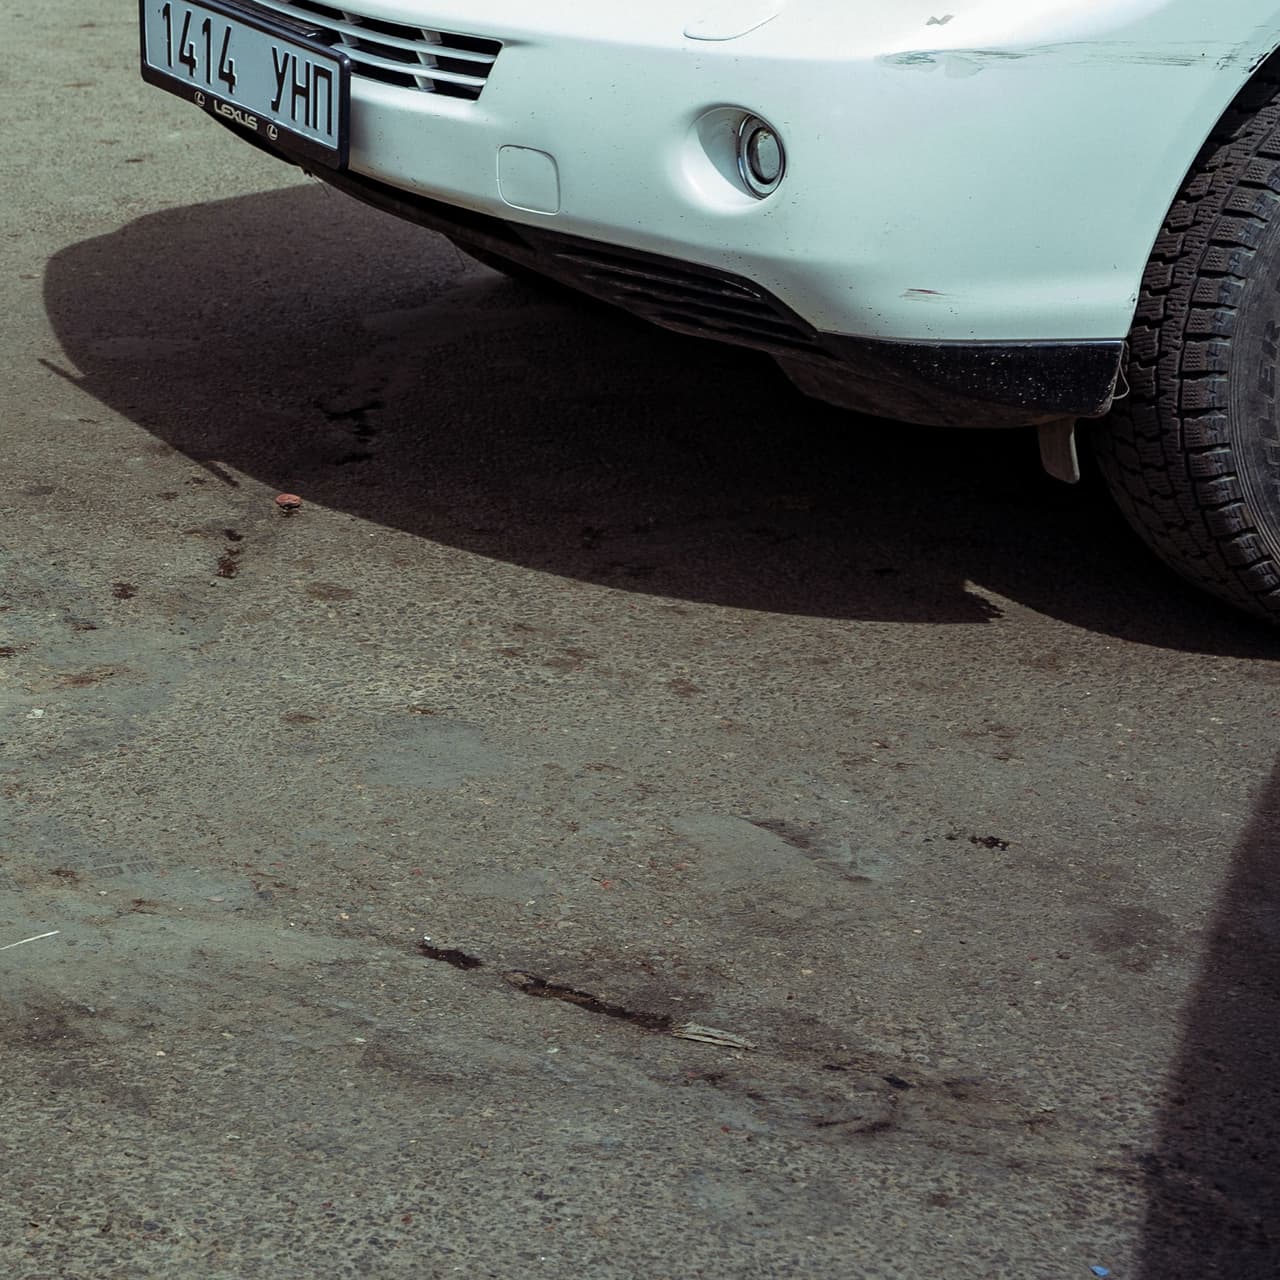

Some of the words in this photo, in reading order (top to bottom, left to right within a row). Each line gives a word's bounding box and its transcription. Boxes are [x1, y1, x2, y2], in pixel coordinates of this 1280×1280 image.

[161, 2, 238, 96] 1414
[270, 45, 334, 138] УНП
[213, 99, 259, 132] LEXUS
